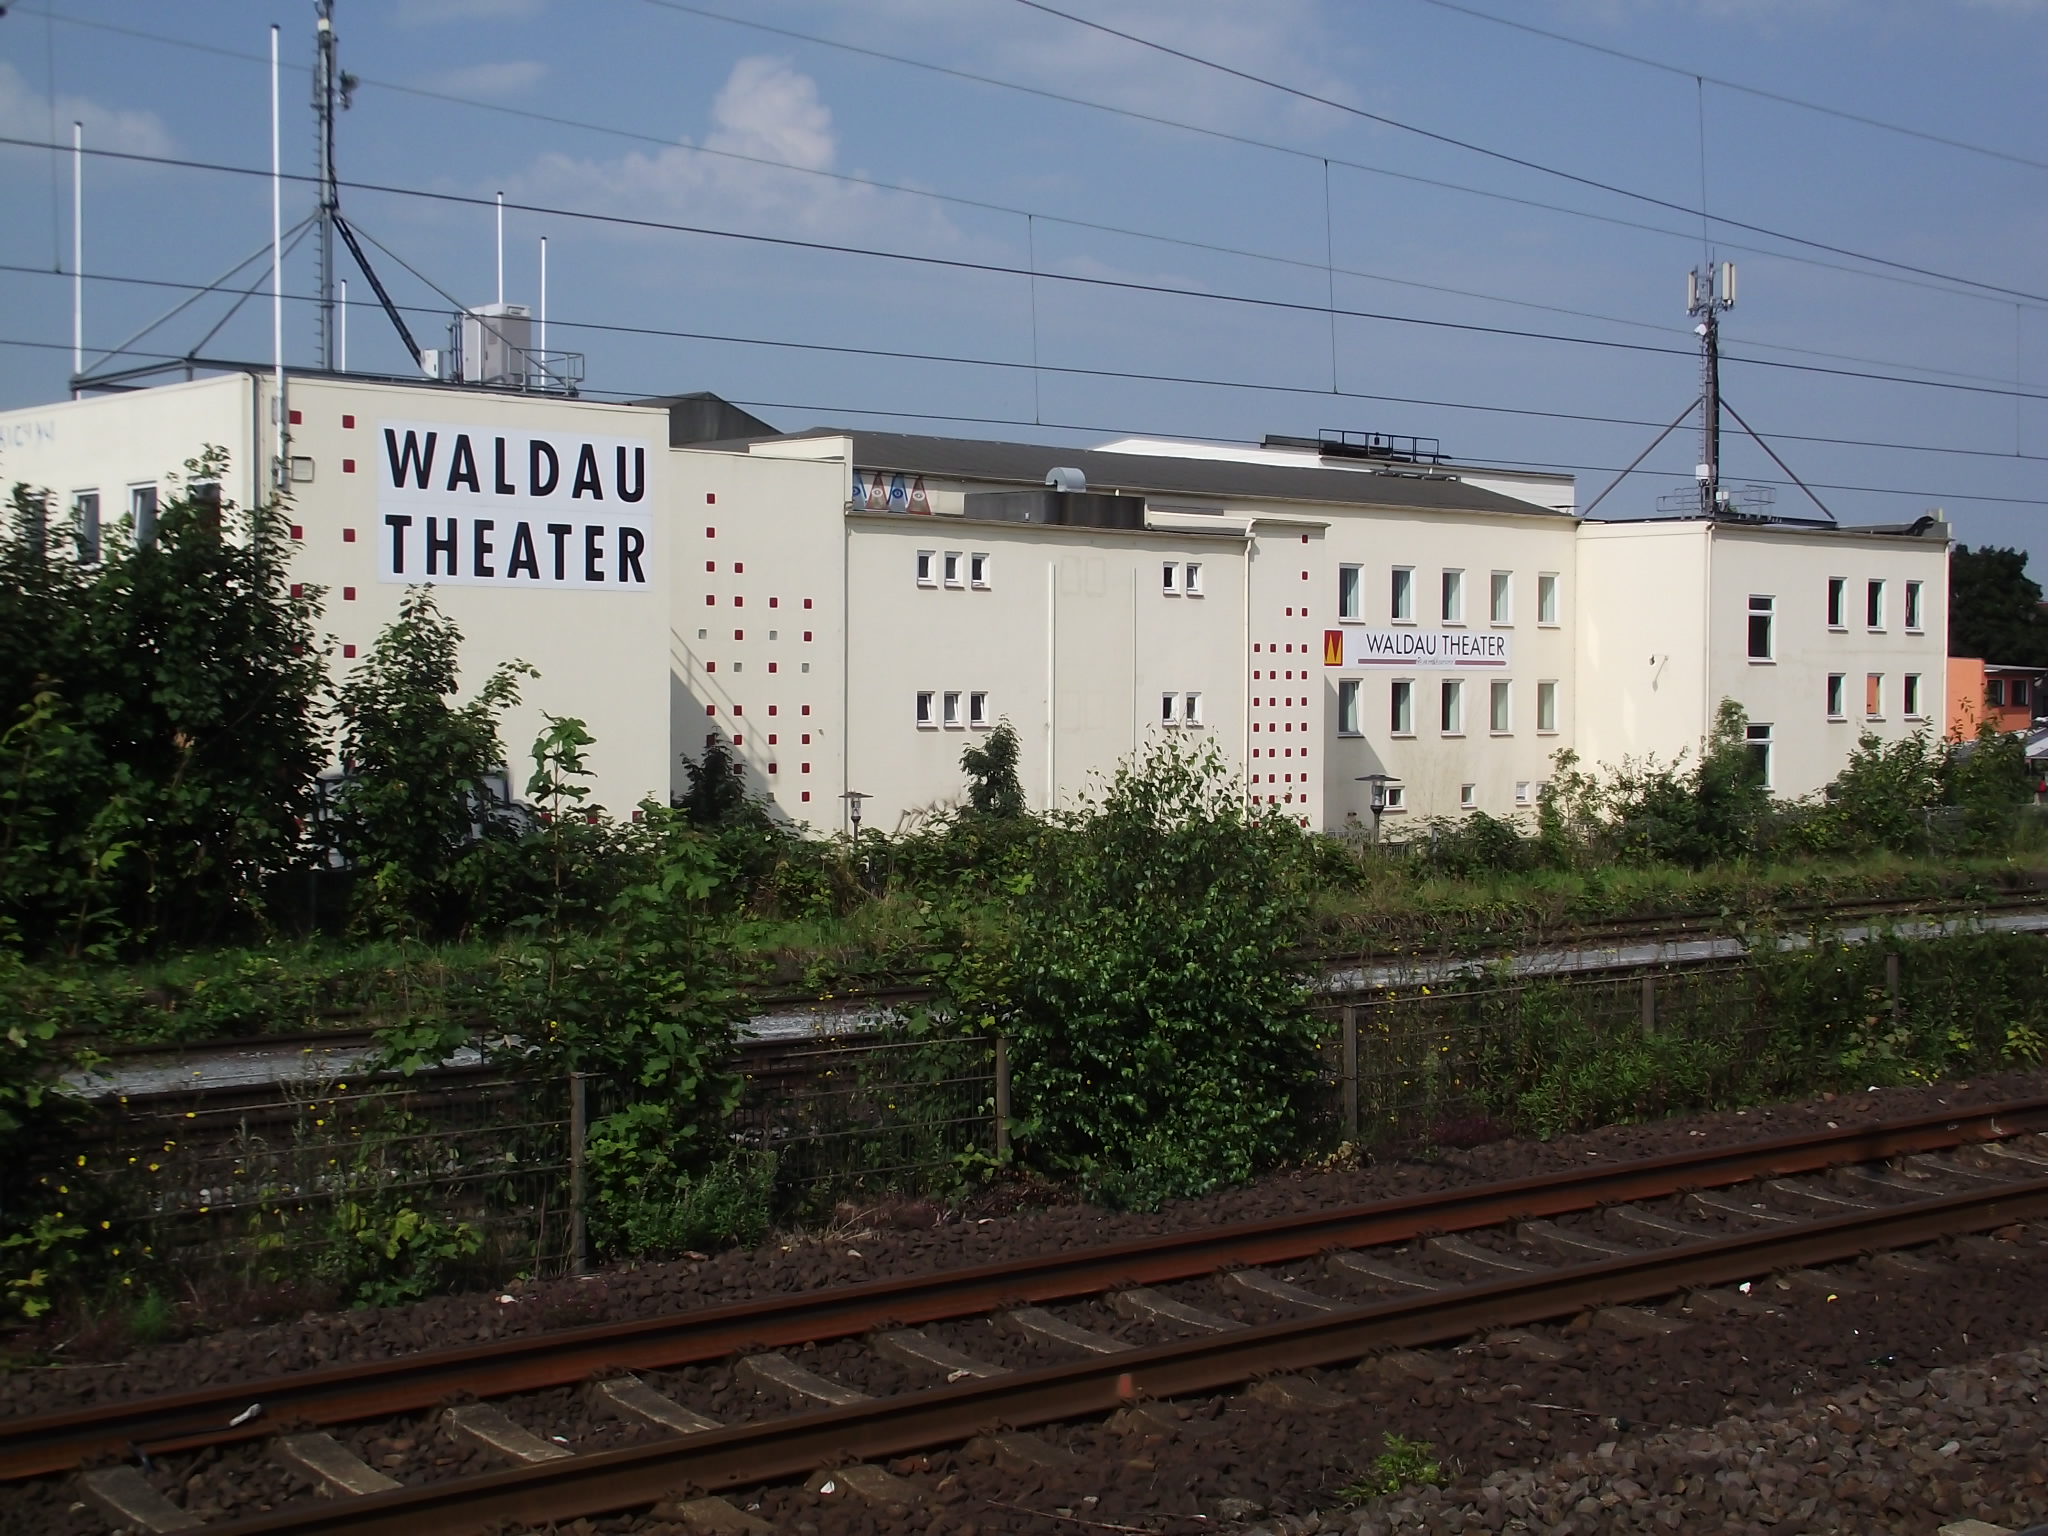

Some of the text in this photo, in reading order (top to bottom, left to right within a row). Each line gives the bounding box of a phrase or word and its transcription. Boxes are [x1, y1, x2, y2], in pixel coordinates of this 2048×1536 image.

[384, 428, 645, 503] WALDAU
[384, 514, 646, 583] THEATER
[1366, 633, 1505, 656] WALDAU THEATER
